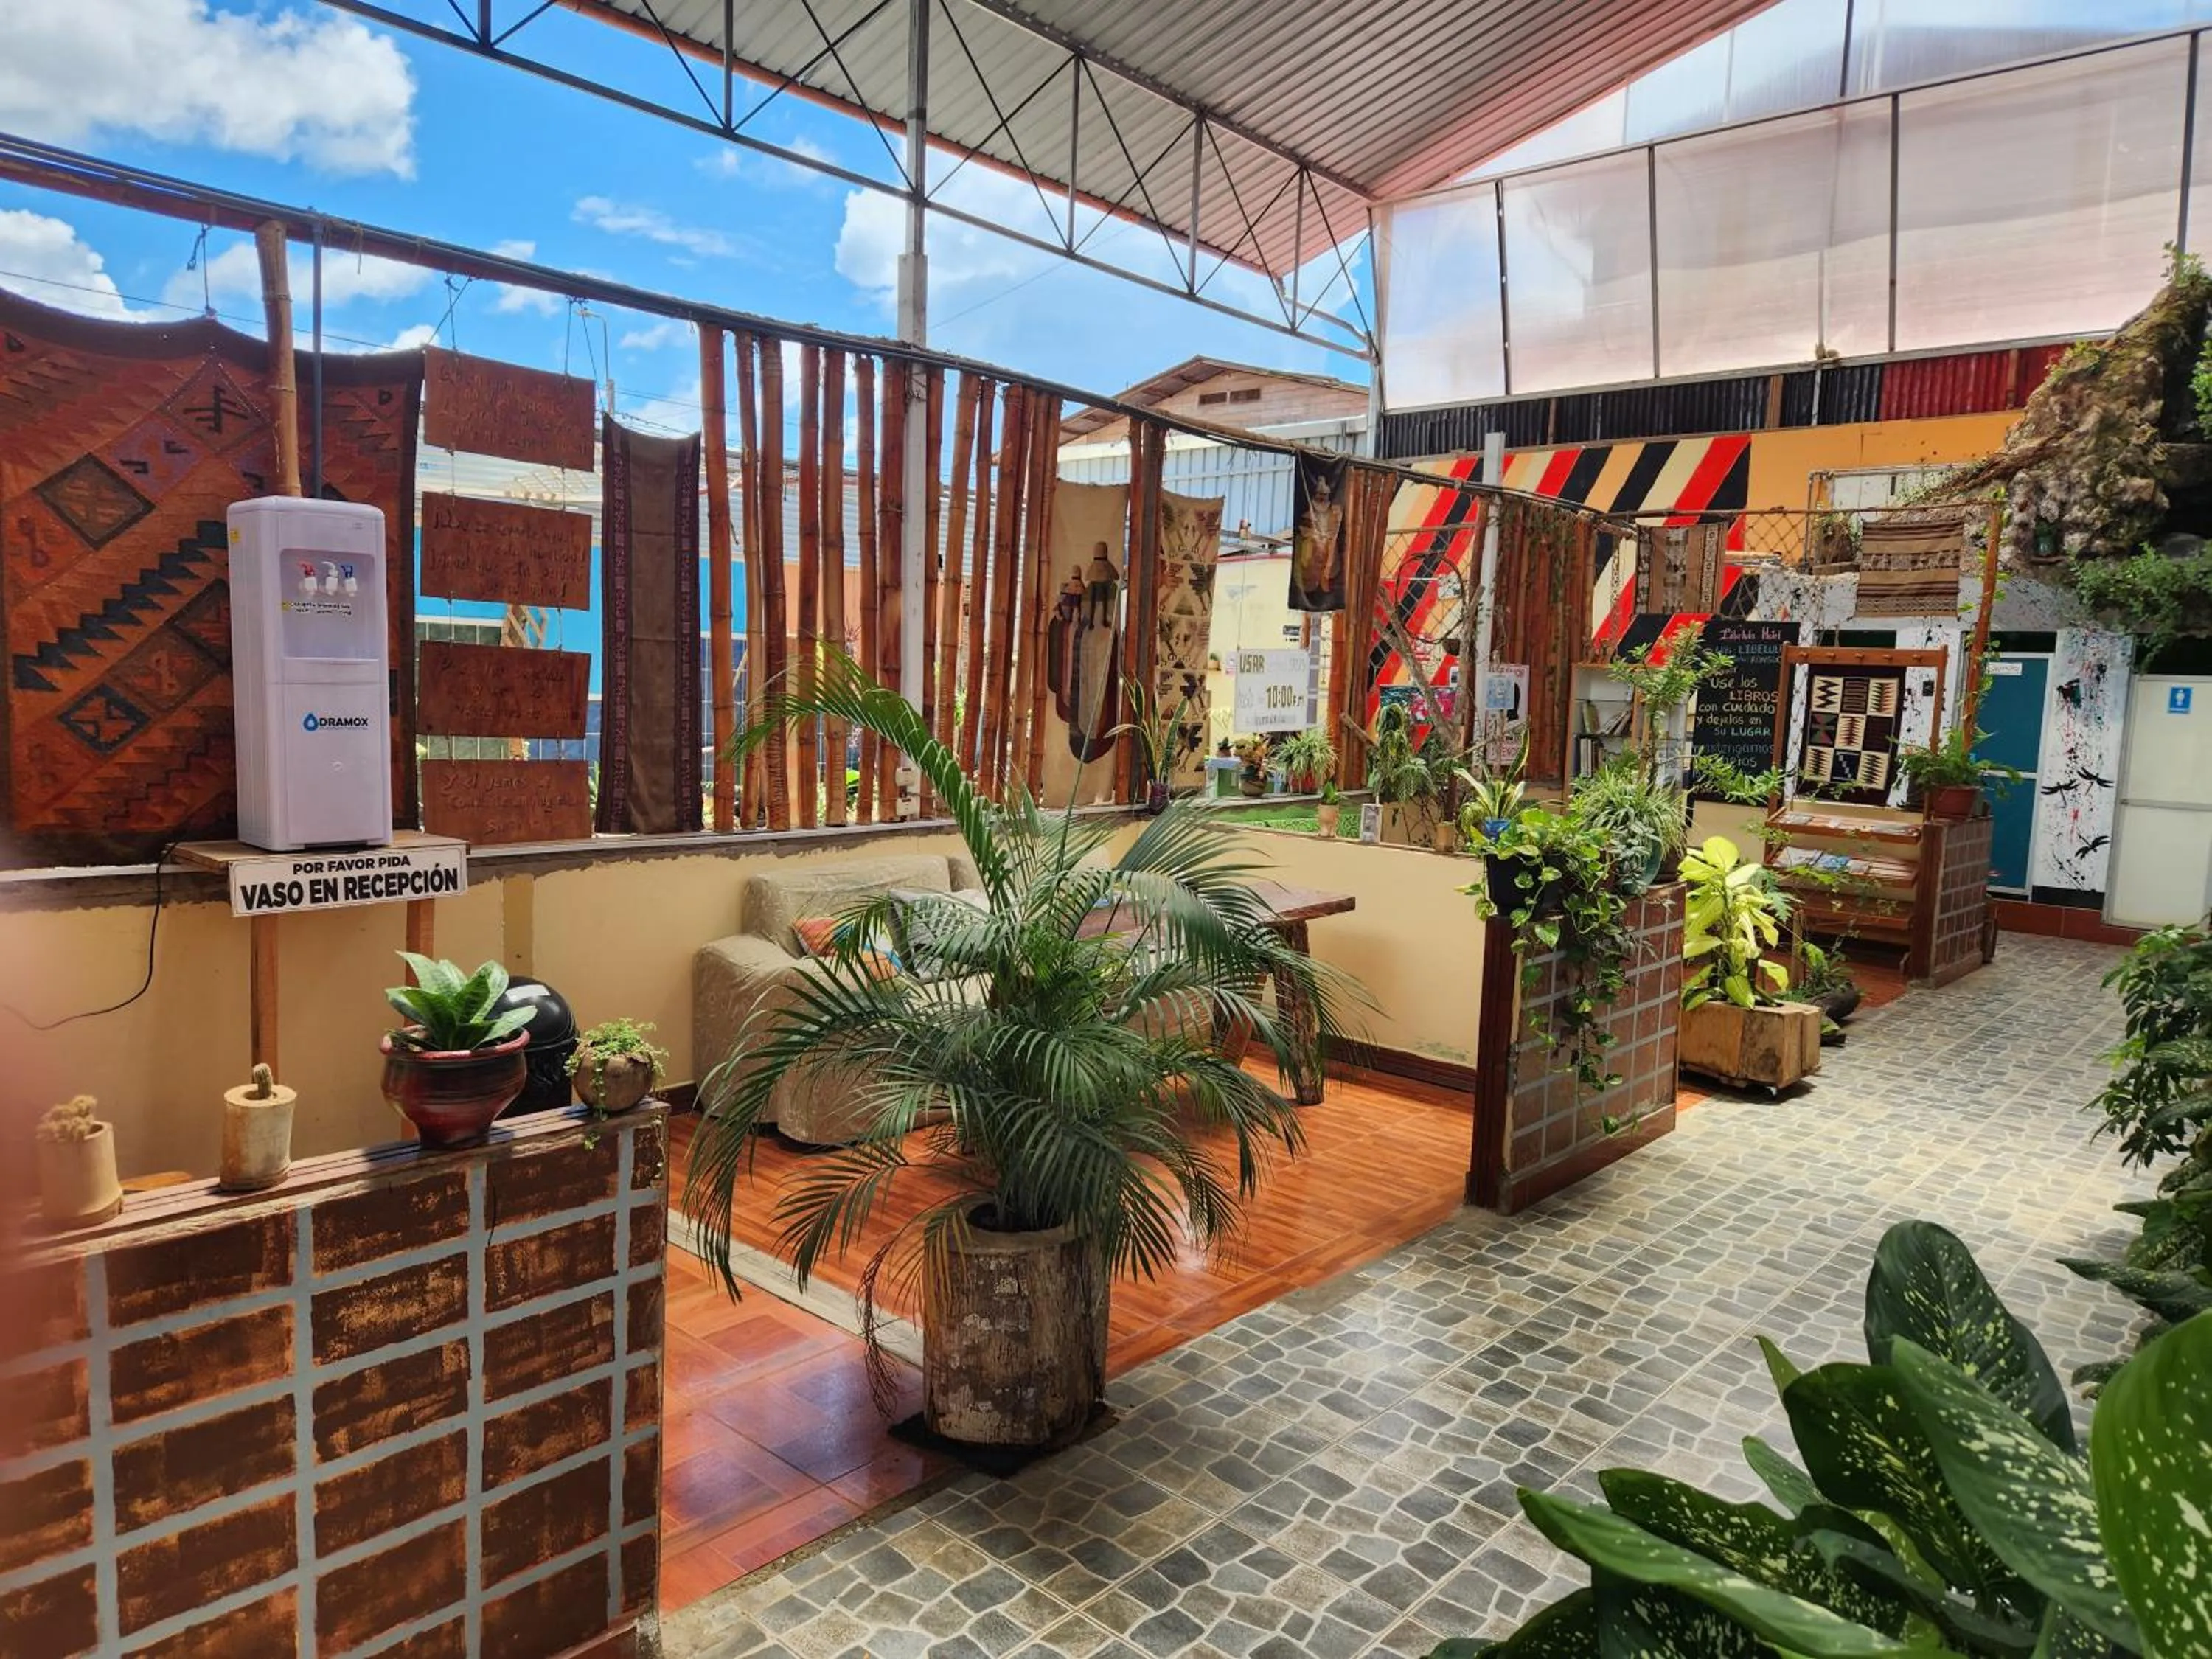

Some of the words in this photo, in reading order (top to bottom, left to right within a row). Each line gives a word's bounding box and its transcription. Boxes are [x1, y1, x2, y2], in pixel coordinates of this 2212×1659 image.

[1239, 654, 1265, 673] USAR
[1741, 674, 1758, 688] los
[1266, 685, 1293, 709] 10:00
[1729, 689, 1779, 703] LIBROS
[1698, 703, 1718, 712] con
[319, 717, 368, 726] DRAMOX
[1749, 717, 1763, 725] en
[1731, 728, 1770, 737] LUGAR
[293, 863, 324, 874] POR
[328, 858, 375, 872] FAVOR
[379, 855, 411, 867] PIDA
[240, 880, 304, 910] VASO
[310, 877, 338, 904] EN
[344, 863, 459, 900] RECEPCIÓN
